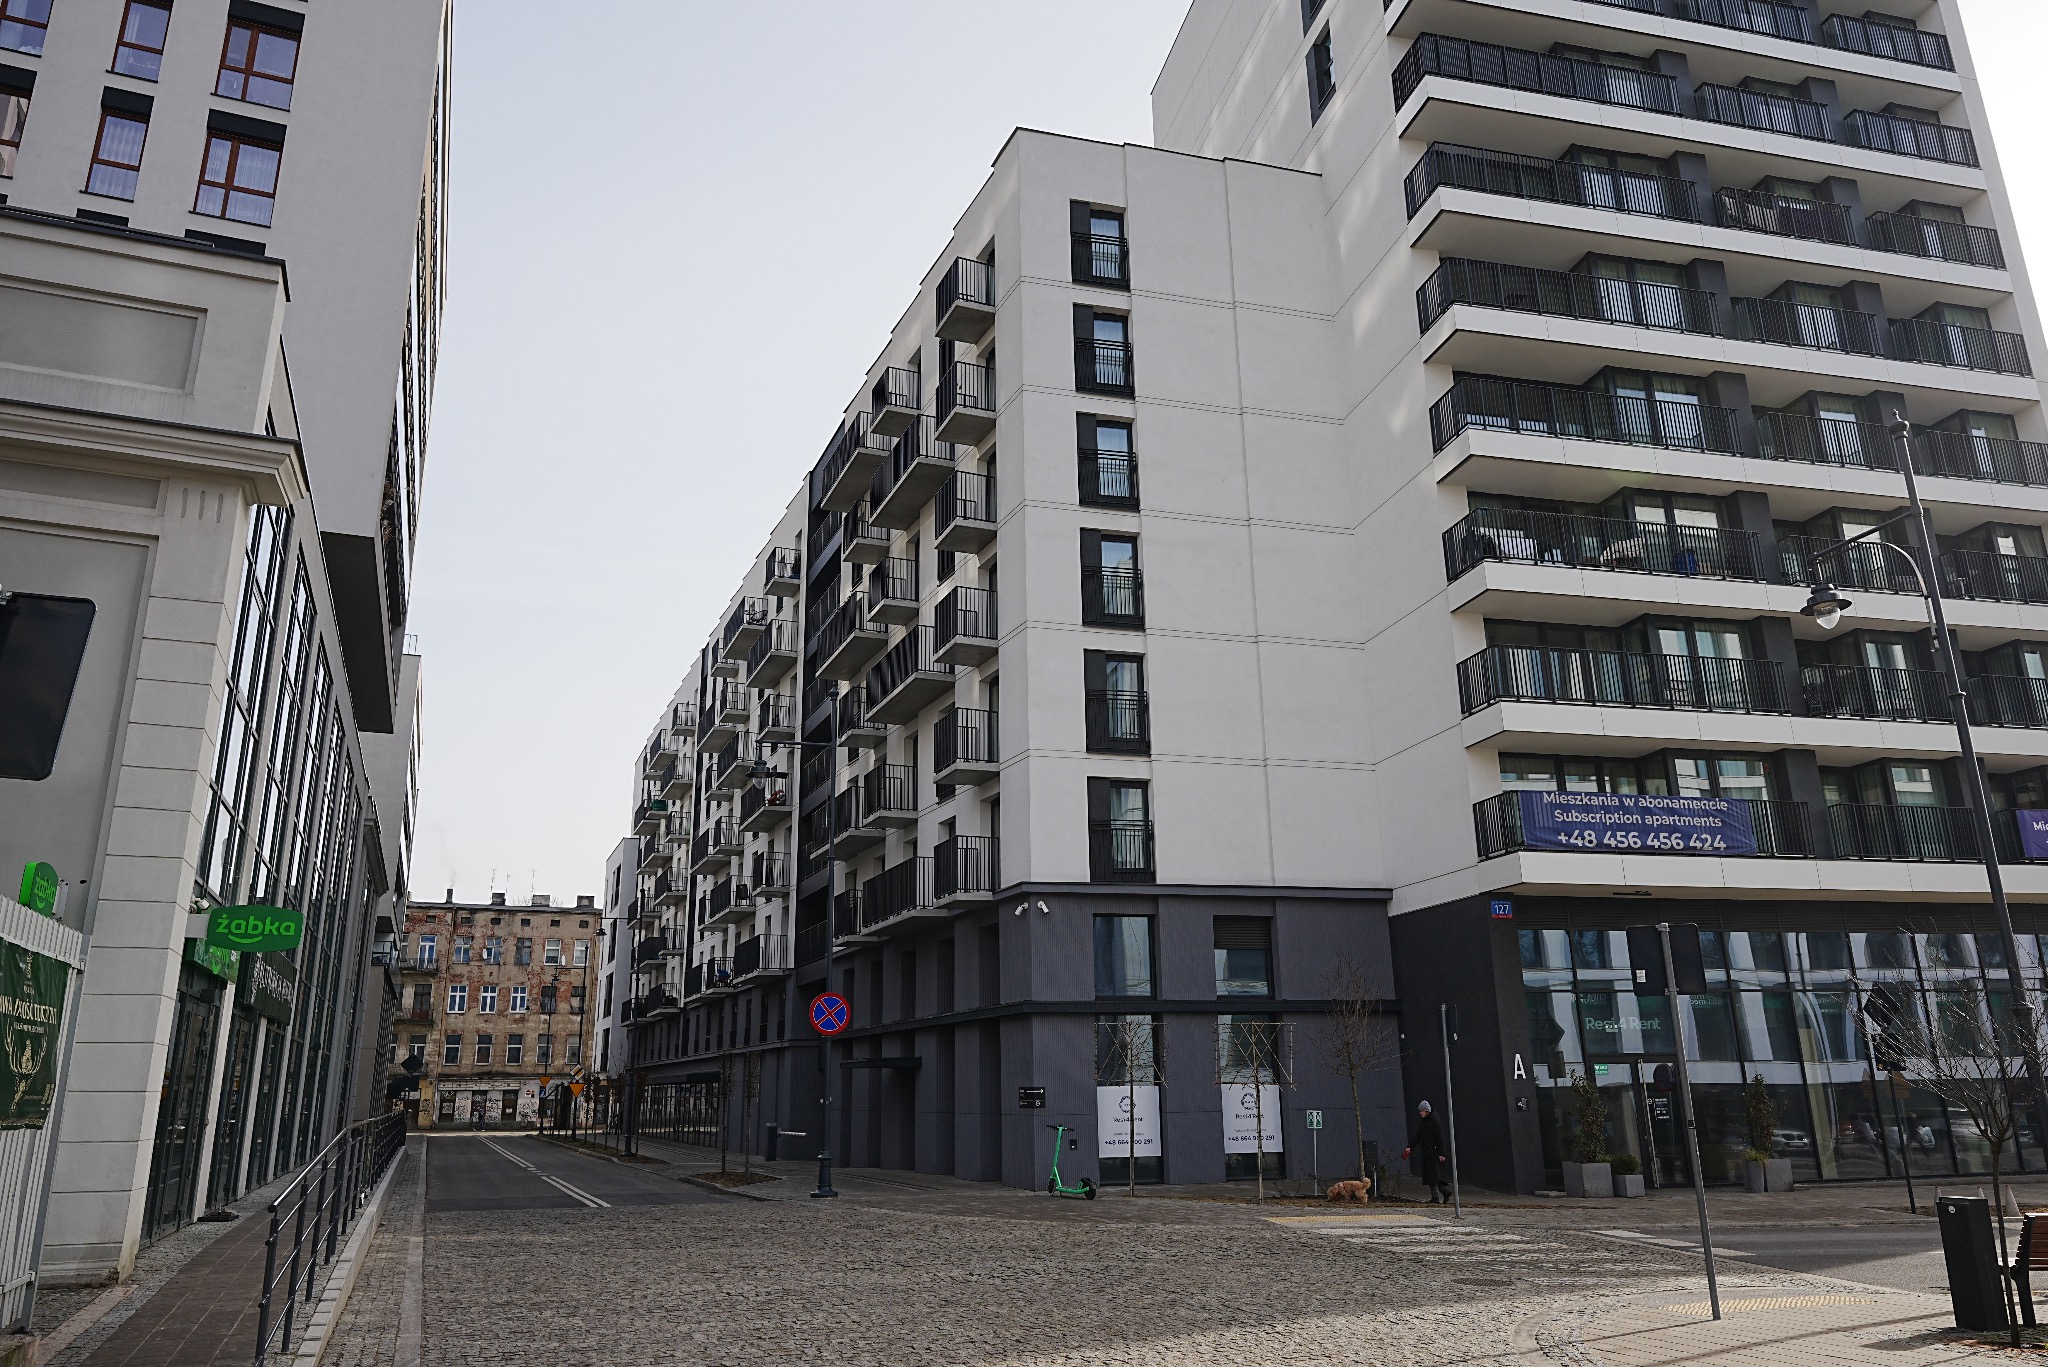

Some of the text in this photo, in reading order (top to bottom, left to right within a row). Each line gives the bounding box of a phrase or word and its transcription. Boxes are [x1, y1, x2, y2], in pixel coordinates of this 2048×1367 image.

[1543, 791, 1728, 811] Mieszkania w abonamencie
[1554, 809, 1722, 827] Subscription apartments
[1558, 829, 1727, 851] +48 456 456 424
[1495, 904, 1509, 914] 127
[215, 913, 296, 936] żabka
[1585, 1017, 1661, 1031] Resi4Rent
[1514, 1053, 1527, 1080] A
